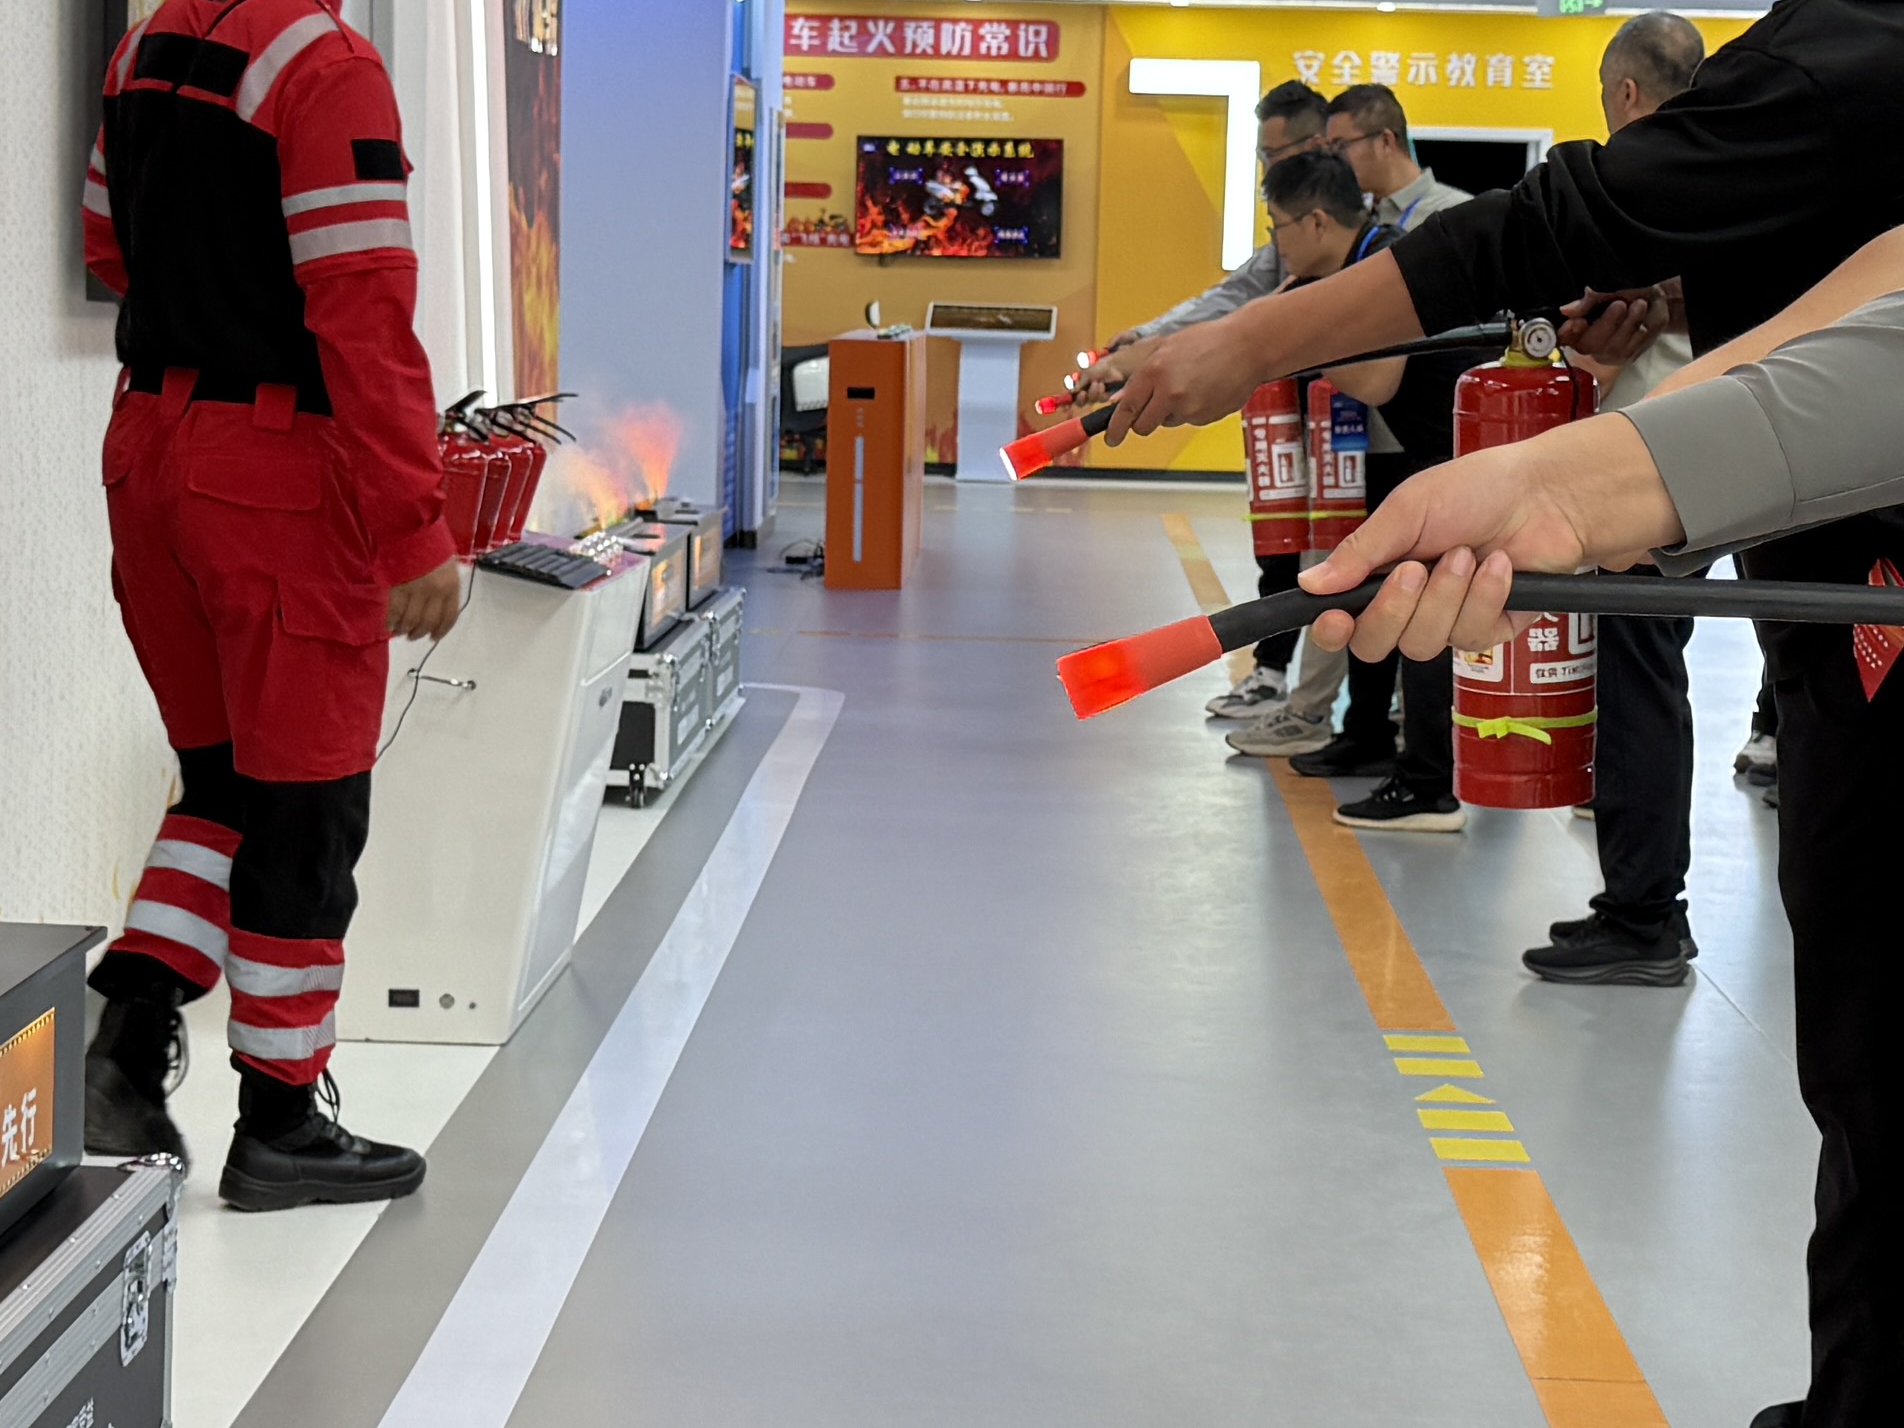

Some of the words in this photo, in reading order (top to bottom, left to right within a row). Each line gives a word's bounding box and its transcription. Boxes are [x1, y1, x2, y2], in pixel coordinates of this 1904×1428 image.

[788, 16, 1049, 59] 车起火预防常识
[1292, 50, 1556, 90] 安全警示教育室
